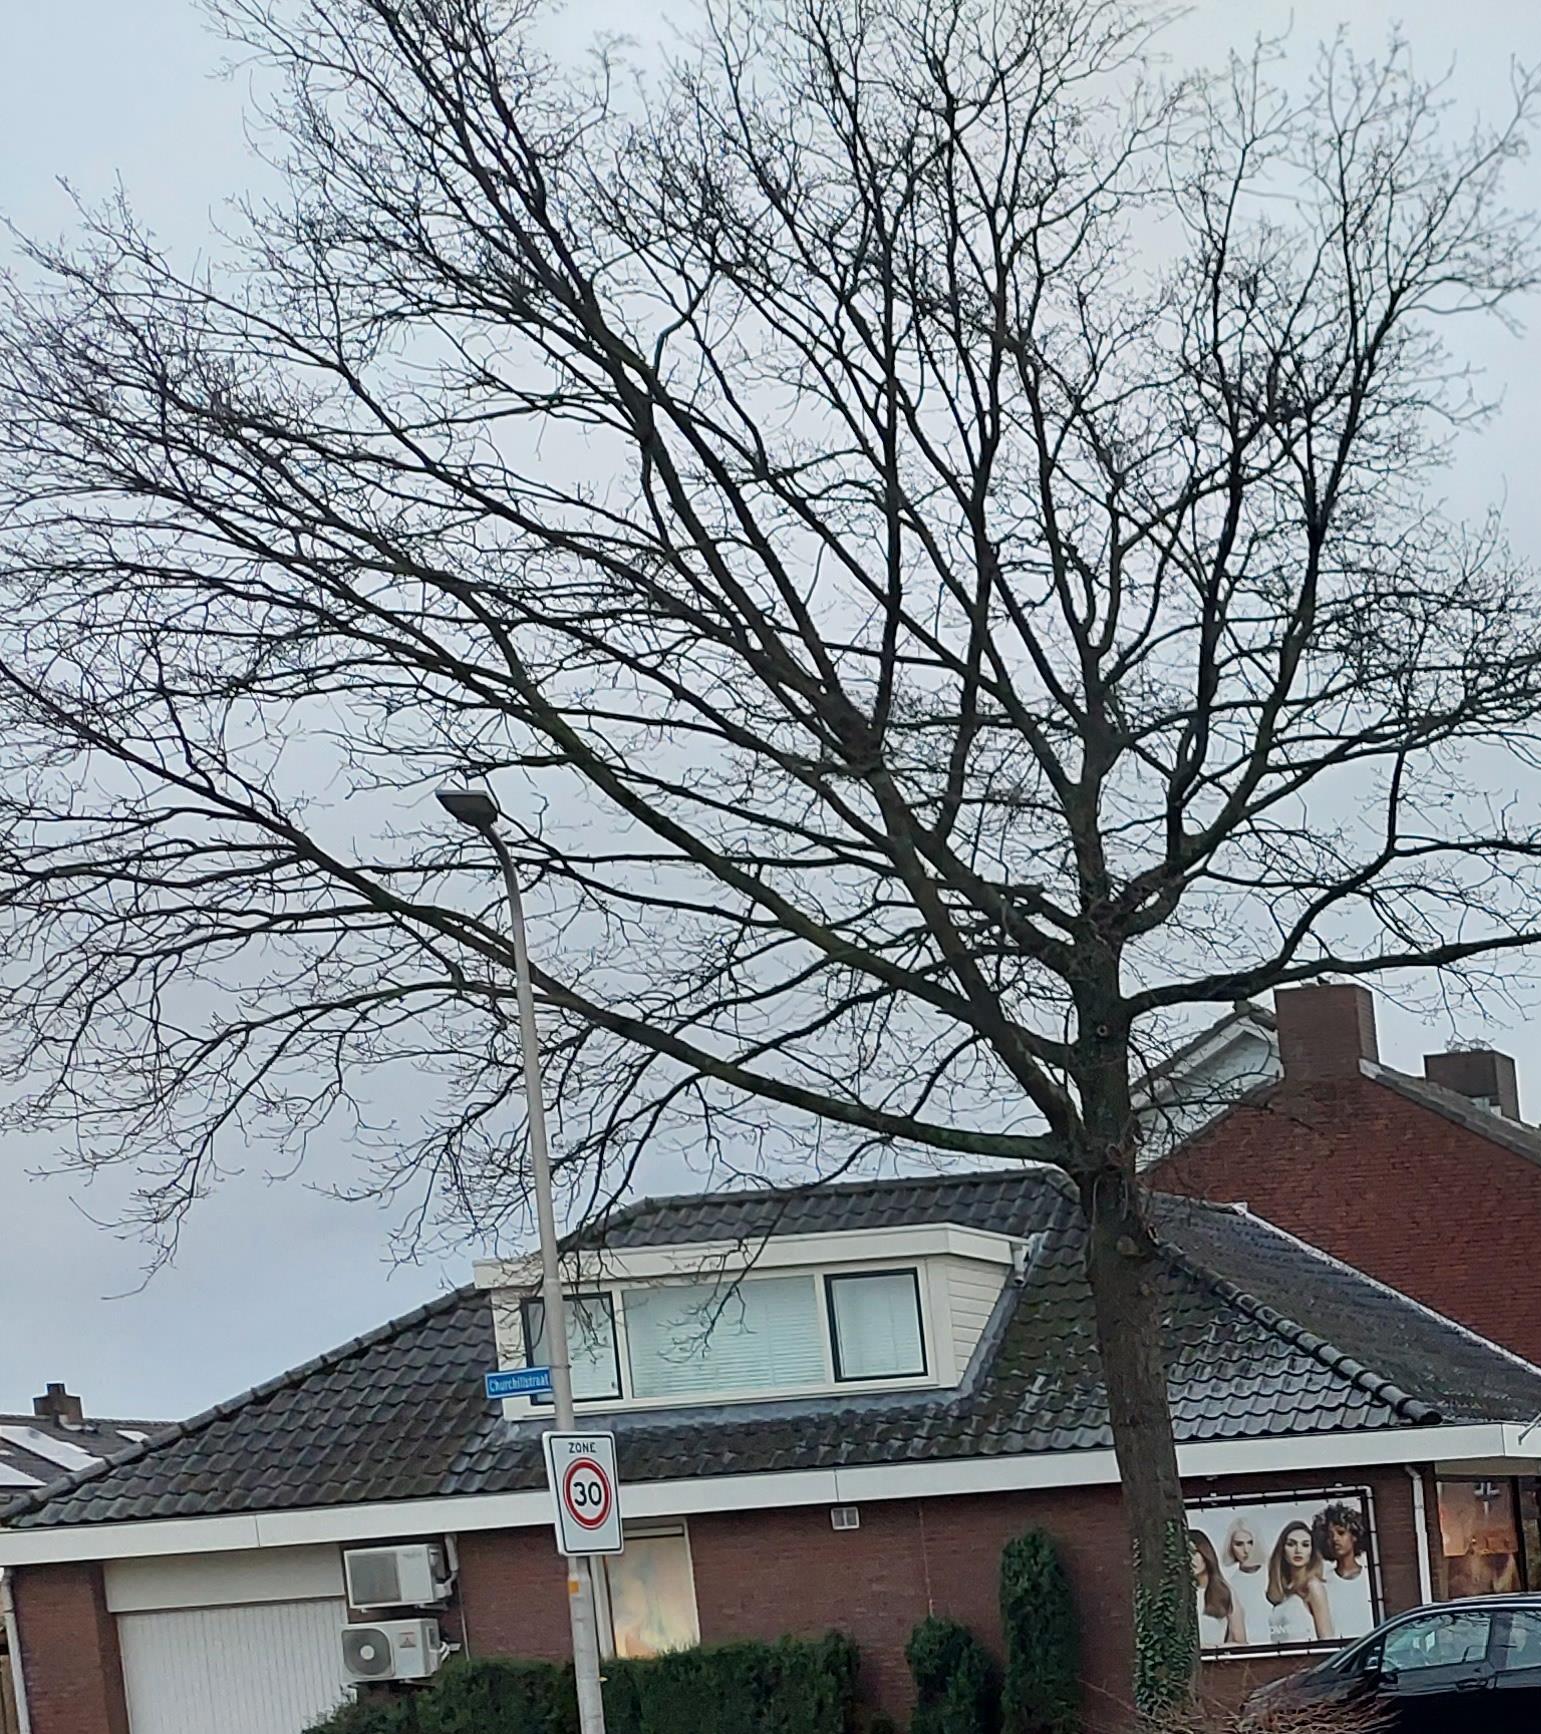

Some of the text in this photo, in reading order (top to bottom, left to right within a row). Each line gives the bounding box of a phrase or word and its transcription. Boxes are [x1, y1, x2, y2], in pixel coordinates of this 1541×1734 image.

[489, 1374, 549, 1392] Churchillstraat
[568, 1442, 597, 1453] ZONE
[573, 1482, 602, 1506] 30
